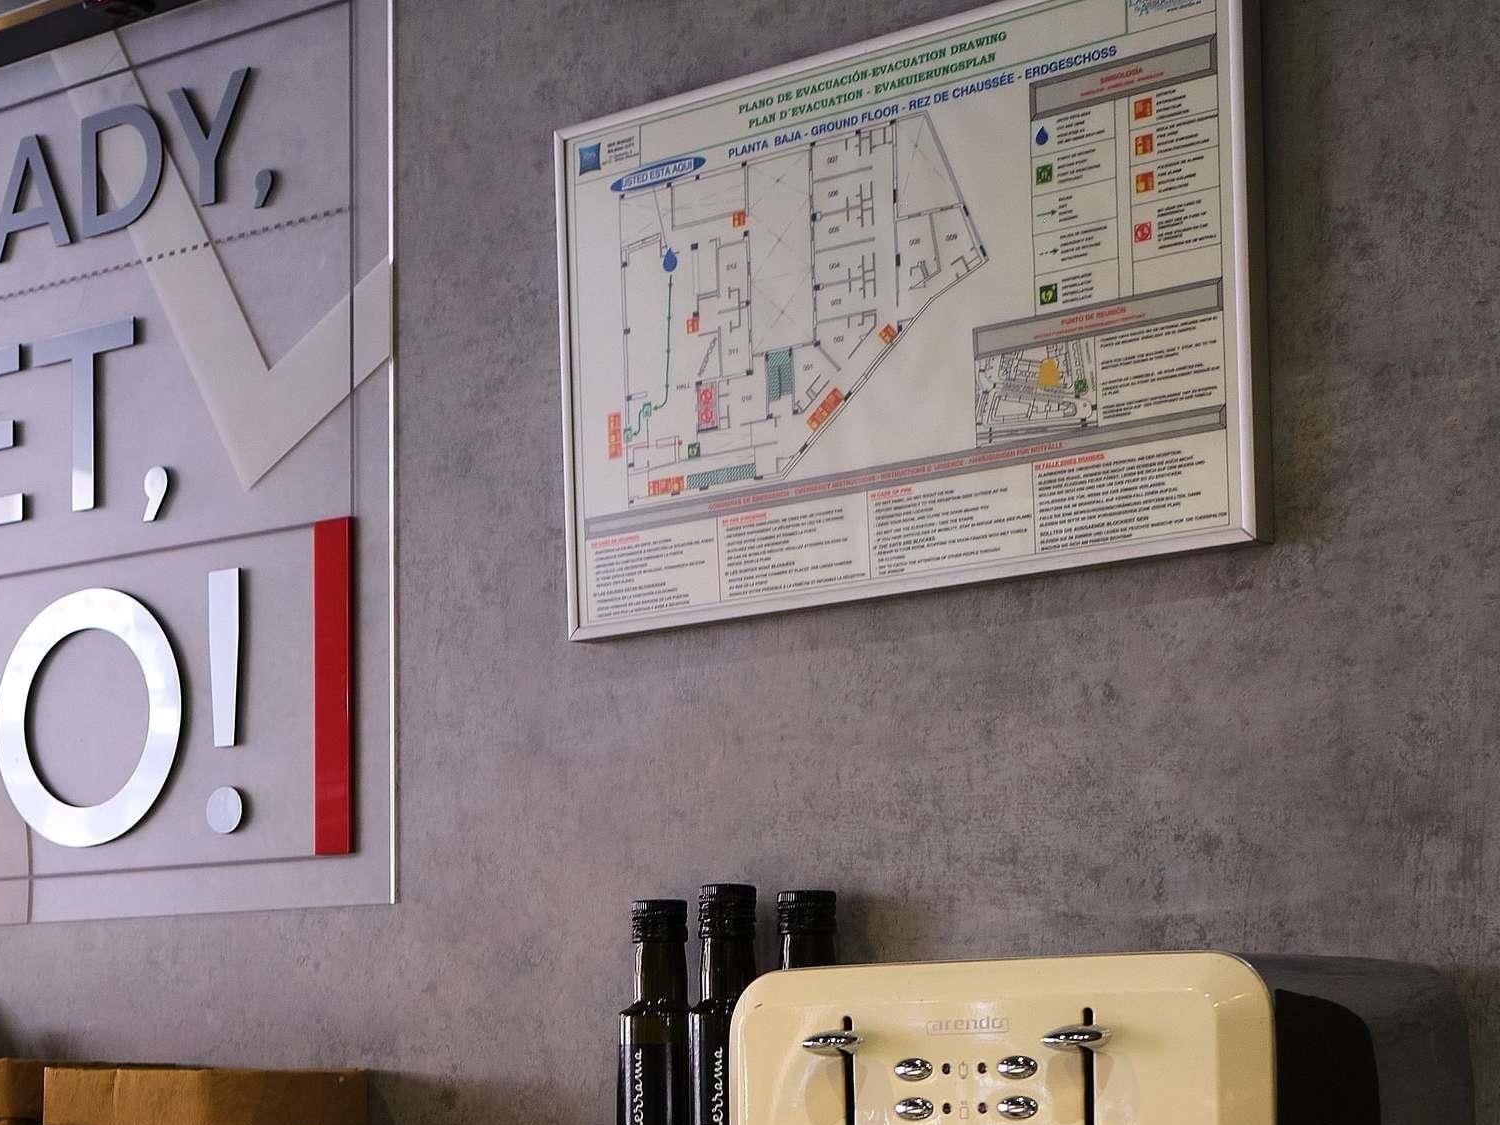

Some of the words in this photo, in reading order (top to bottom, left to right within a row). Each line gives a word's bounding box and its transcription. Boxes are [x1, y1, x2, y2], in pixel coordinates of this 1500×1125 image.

[728, 139, 768, 159] PLANTA
[774, 130, 801, 146] BAJA
[811, 115, 858, 137] GROUND
[861, 104, 899, 126] FLOOR
[909, 96, 932, 112] REZ
[934, 90, 949, 104] DE
[952, 71, 1014, 99] CHAUSSÉE
[1025, 45, 1118, 79] ERDGESCHOSS
[738, 95, 774, 114] PLANO
[777, 91, 793, 105] DE
[950, 31, 1007, 58] DRAWING
[748, 113, 776, 129] PLAN
[874, 52, 996, 94] EVAKUIERUNGSPLAN
[931, 1016, 1005, 1031] arendo
